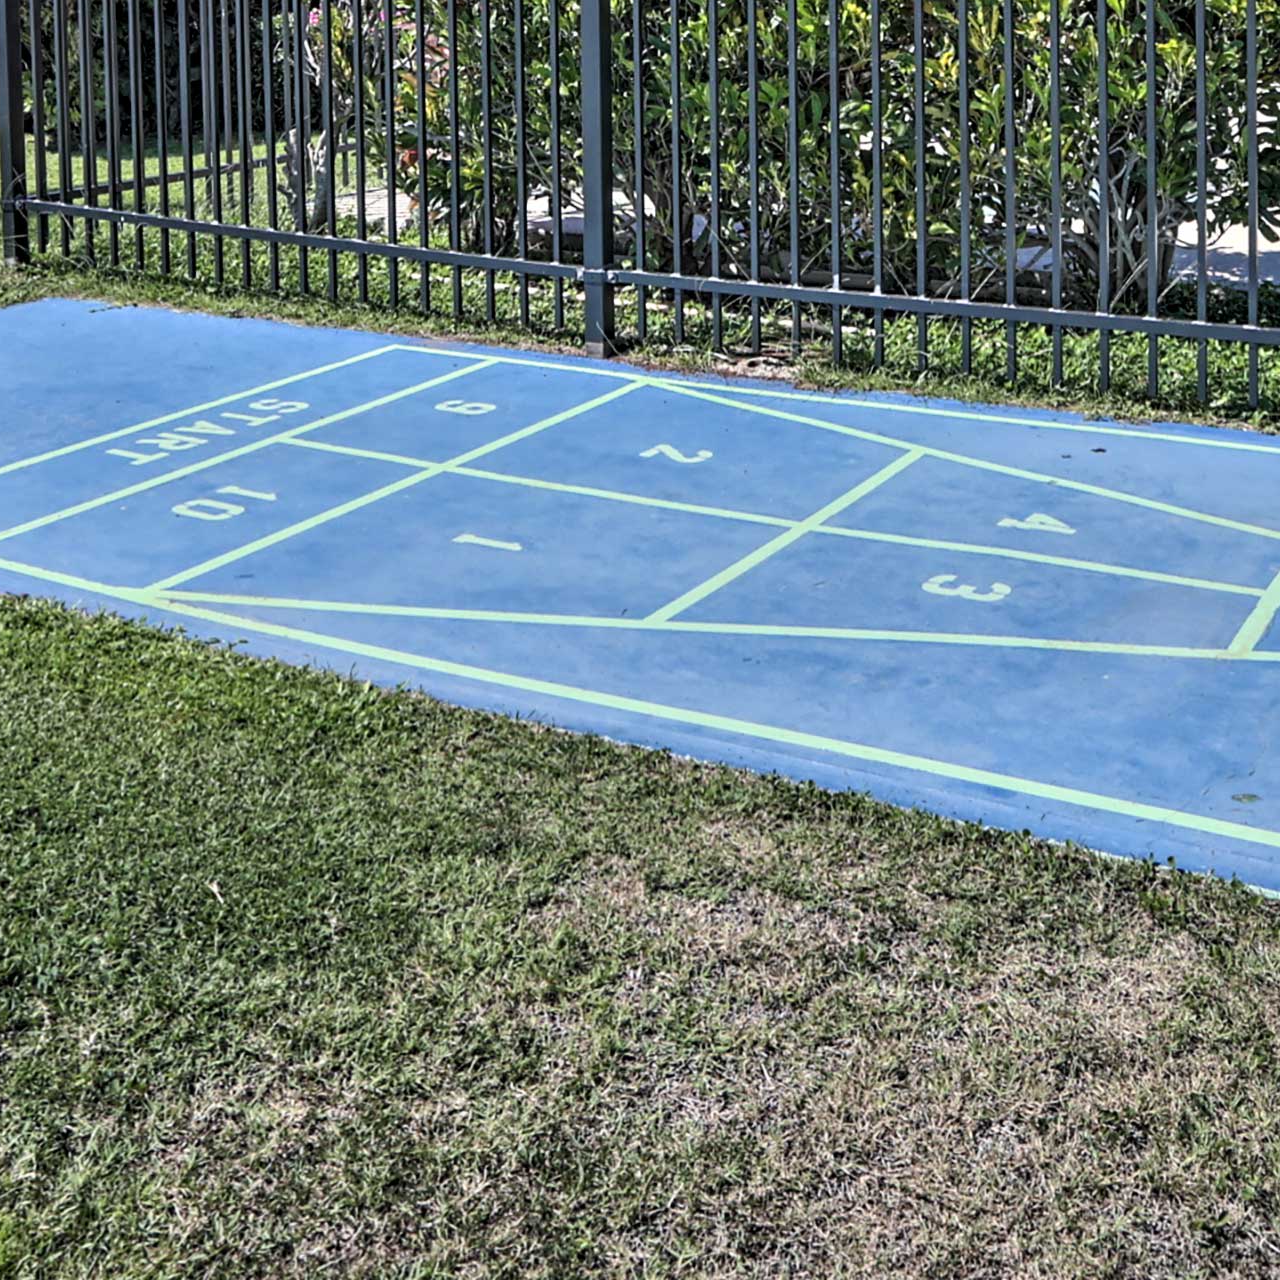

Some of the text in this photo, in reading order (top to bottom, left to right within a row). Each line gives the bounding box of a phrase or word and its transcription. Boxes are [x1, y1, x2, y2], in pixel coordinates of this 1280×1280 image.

[434, 400, 497, 416] 9
[106, 399, 310, 466] START
[638, 443, 714, 464] 2
[170, 485, 278, 521] 10
[996, 512, 1077, 535] 4
[451, 533, 523, 552] 1
[921, 574, 1012, 603] 3
